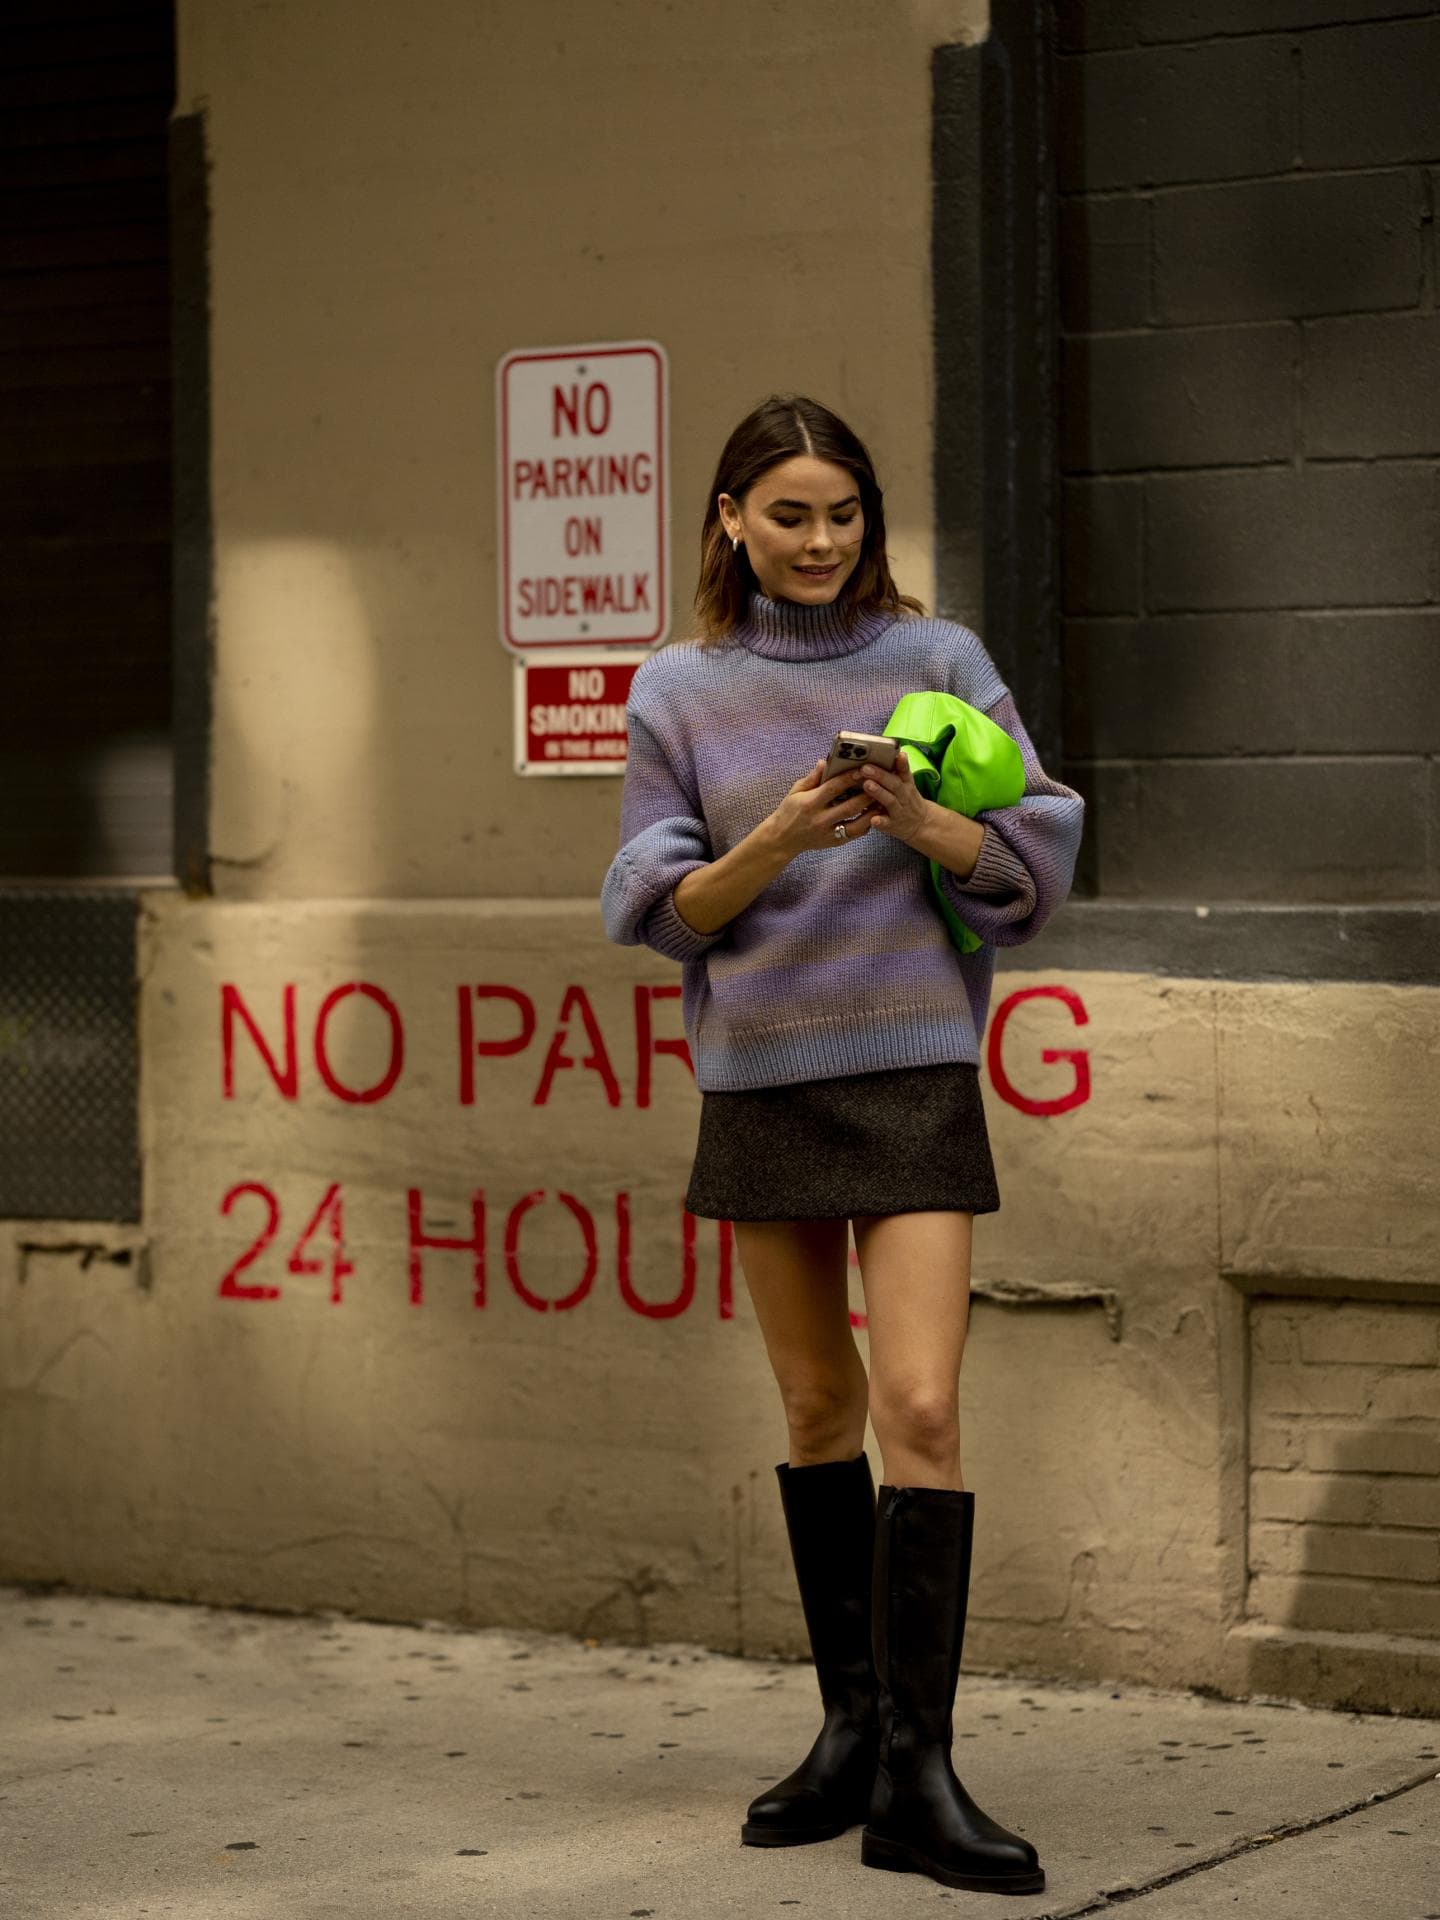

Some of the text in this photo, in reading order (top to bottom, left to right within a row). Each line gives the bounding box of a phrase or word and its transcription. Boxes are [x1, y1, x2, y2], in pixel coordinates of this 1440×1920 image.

[553, 382, 611, 438] NO
[514, 453, 651, 501] PARKING
[564, 515, 602, 557] ON
[517, 573, 650, 618] SIDEWALK
[568, 668, 605, 701] NO
[530, 704, 627, 737] SMOKIN
[220, 983, 1092, 1117] NO PARG
[218, 1181, 868, 1329] 24 HOU
